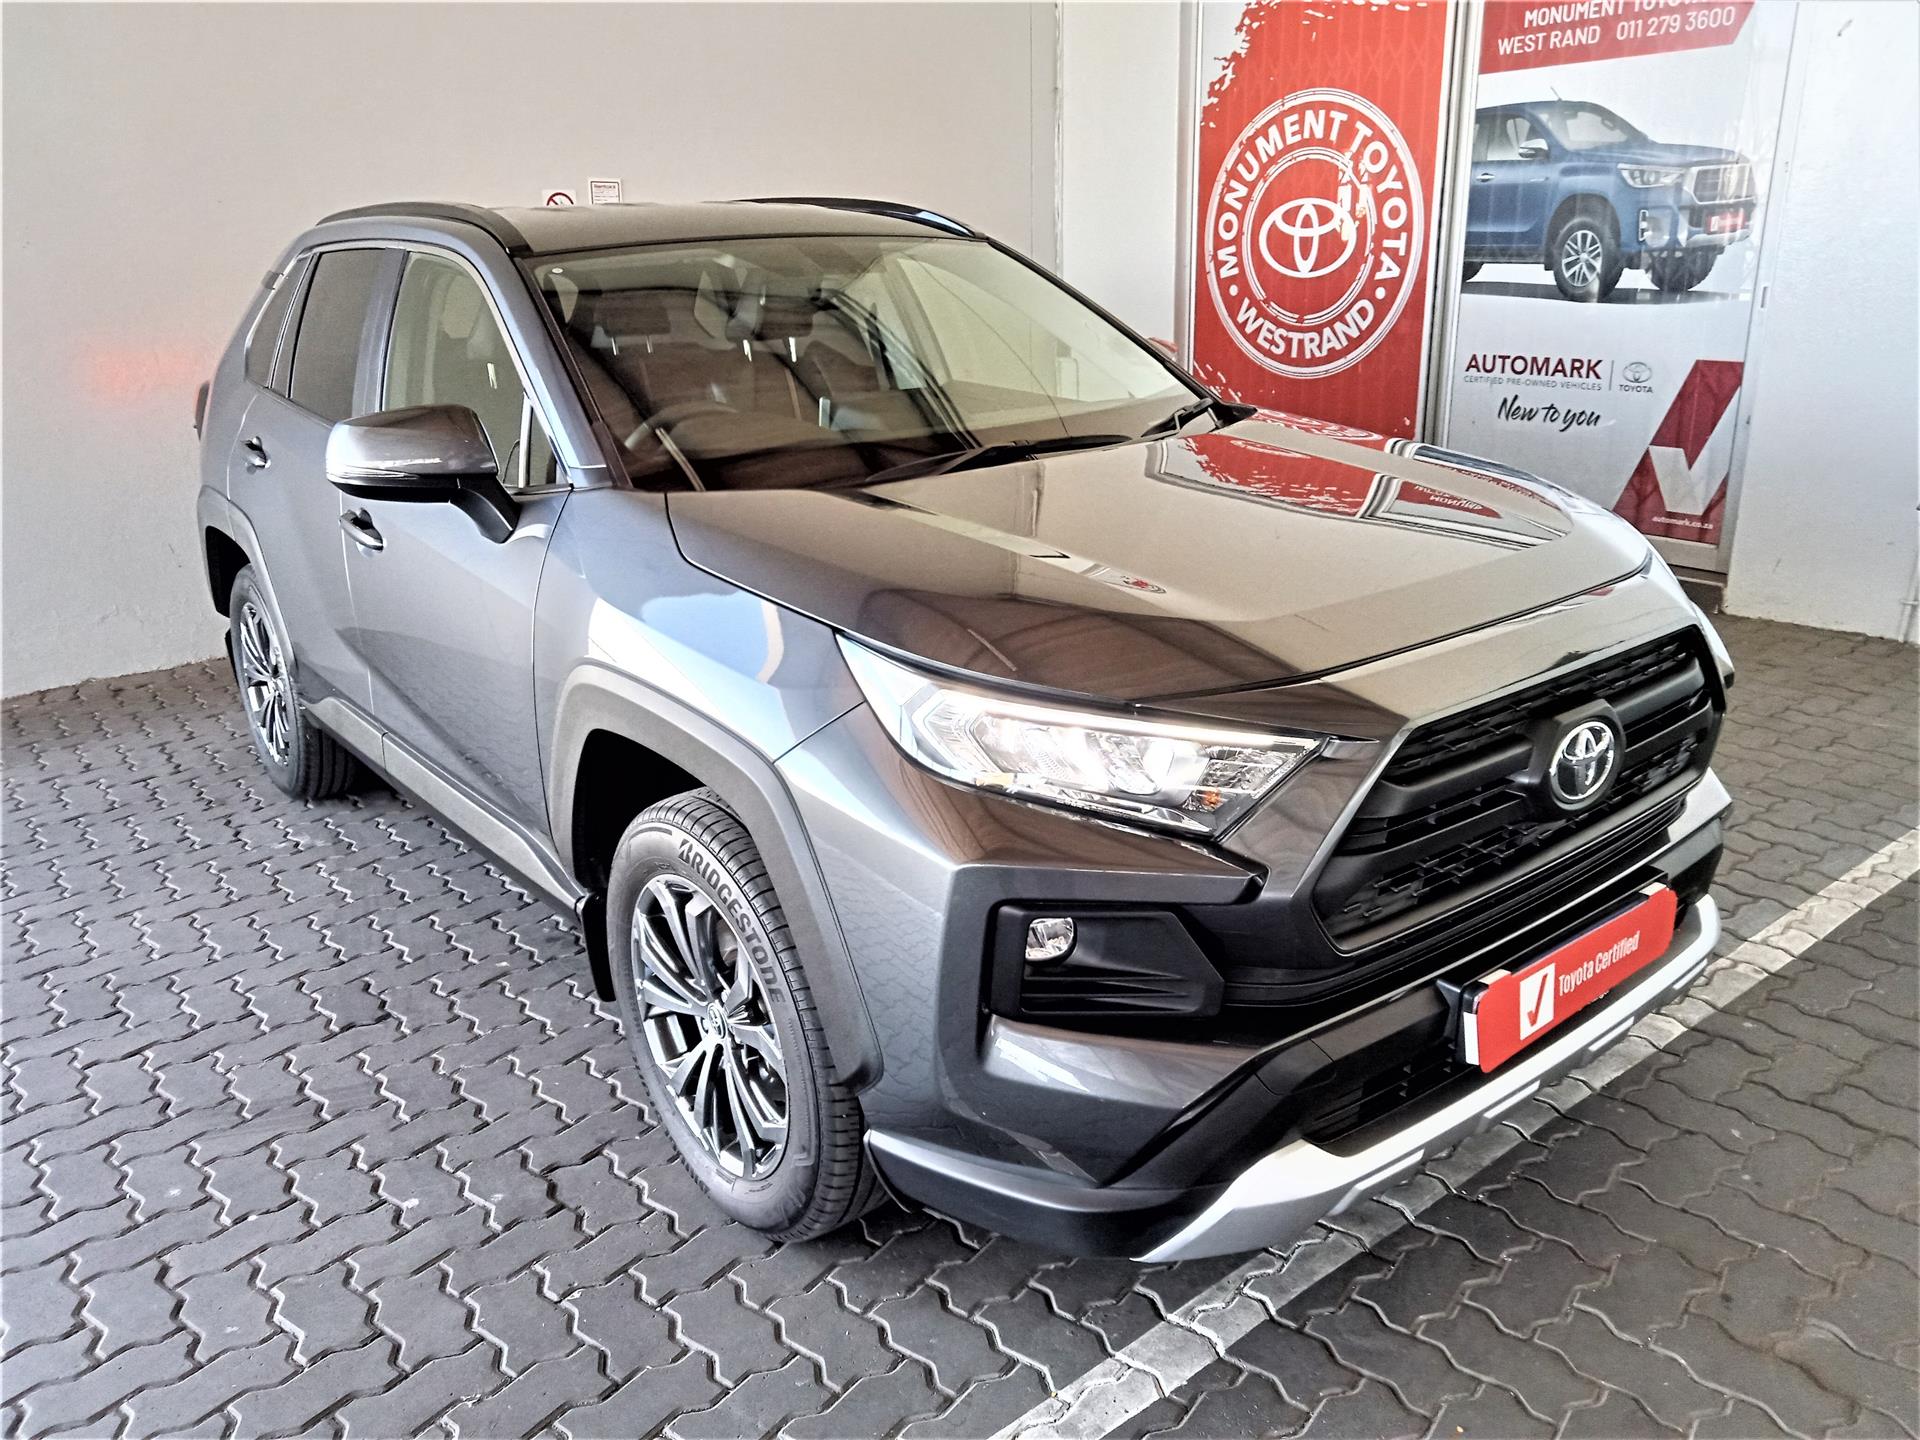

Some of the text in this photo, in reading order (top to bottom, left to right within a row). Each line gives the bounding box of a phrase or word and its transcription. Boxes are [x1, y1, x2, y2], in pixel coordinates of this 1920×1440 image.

[1497, 6, 1735, 55] WEST RAND 011 279 3600
[1523, 0, 1624, 28] MONUMENT
[1216, 109, 1408, 280] MONUMENT TOYOTA
[1235, 298, 1375, 359] WESTRAND
[1463, 375, 1602, 391] CERTIFIED PRE-OWNED VEHICLES
[1465, 353, 1603, 380] AUTOMARK
[1619, 384, 1654, 394] TOYOTA
[1497, 394, 1601, 433] New to you
[677, 838, 786, 1004] BRIDGESTONE
[1559, 930, 1641, 996] Toyota Certified
